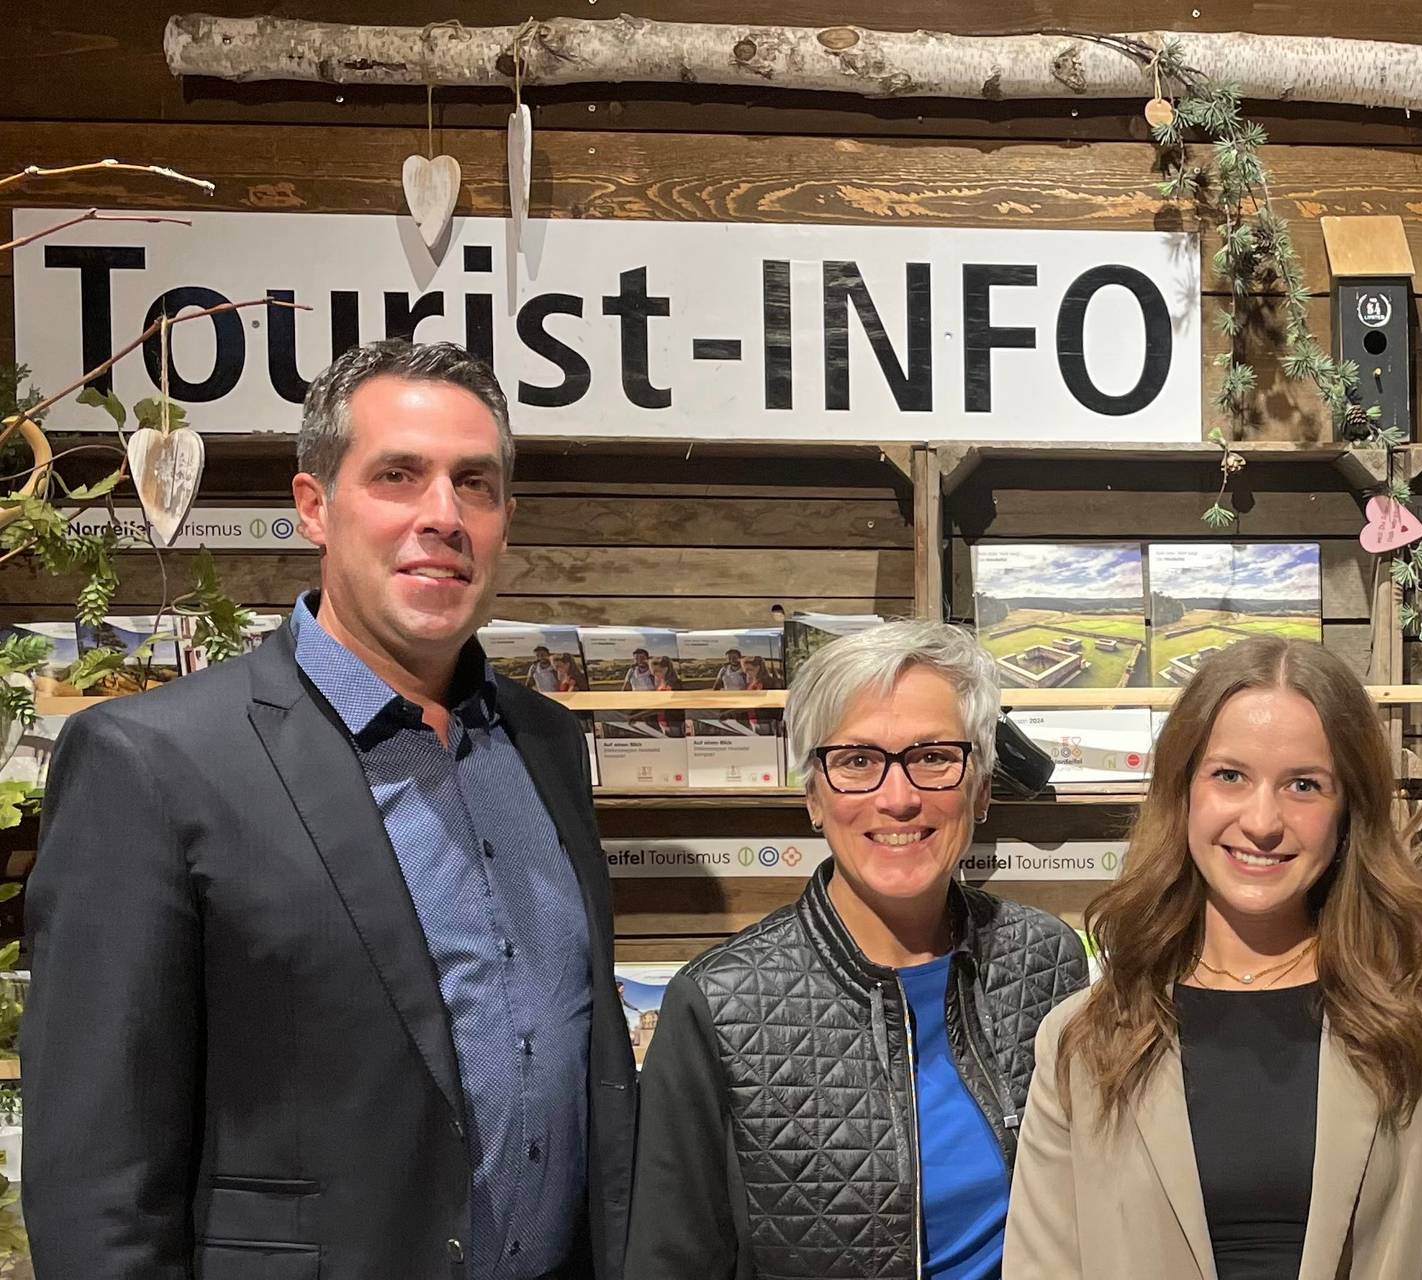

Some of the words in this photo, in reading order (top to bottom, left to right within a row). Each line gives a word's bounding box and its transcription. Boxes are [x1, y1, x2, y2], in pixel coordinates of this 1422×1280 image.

[607, 850, 645, 865] eifel
[648, 850, 731, 866] Tourismus
[958, 855, 1011, 870] rdeifel
[1015, 855, 1095, 870] Tourismus
